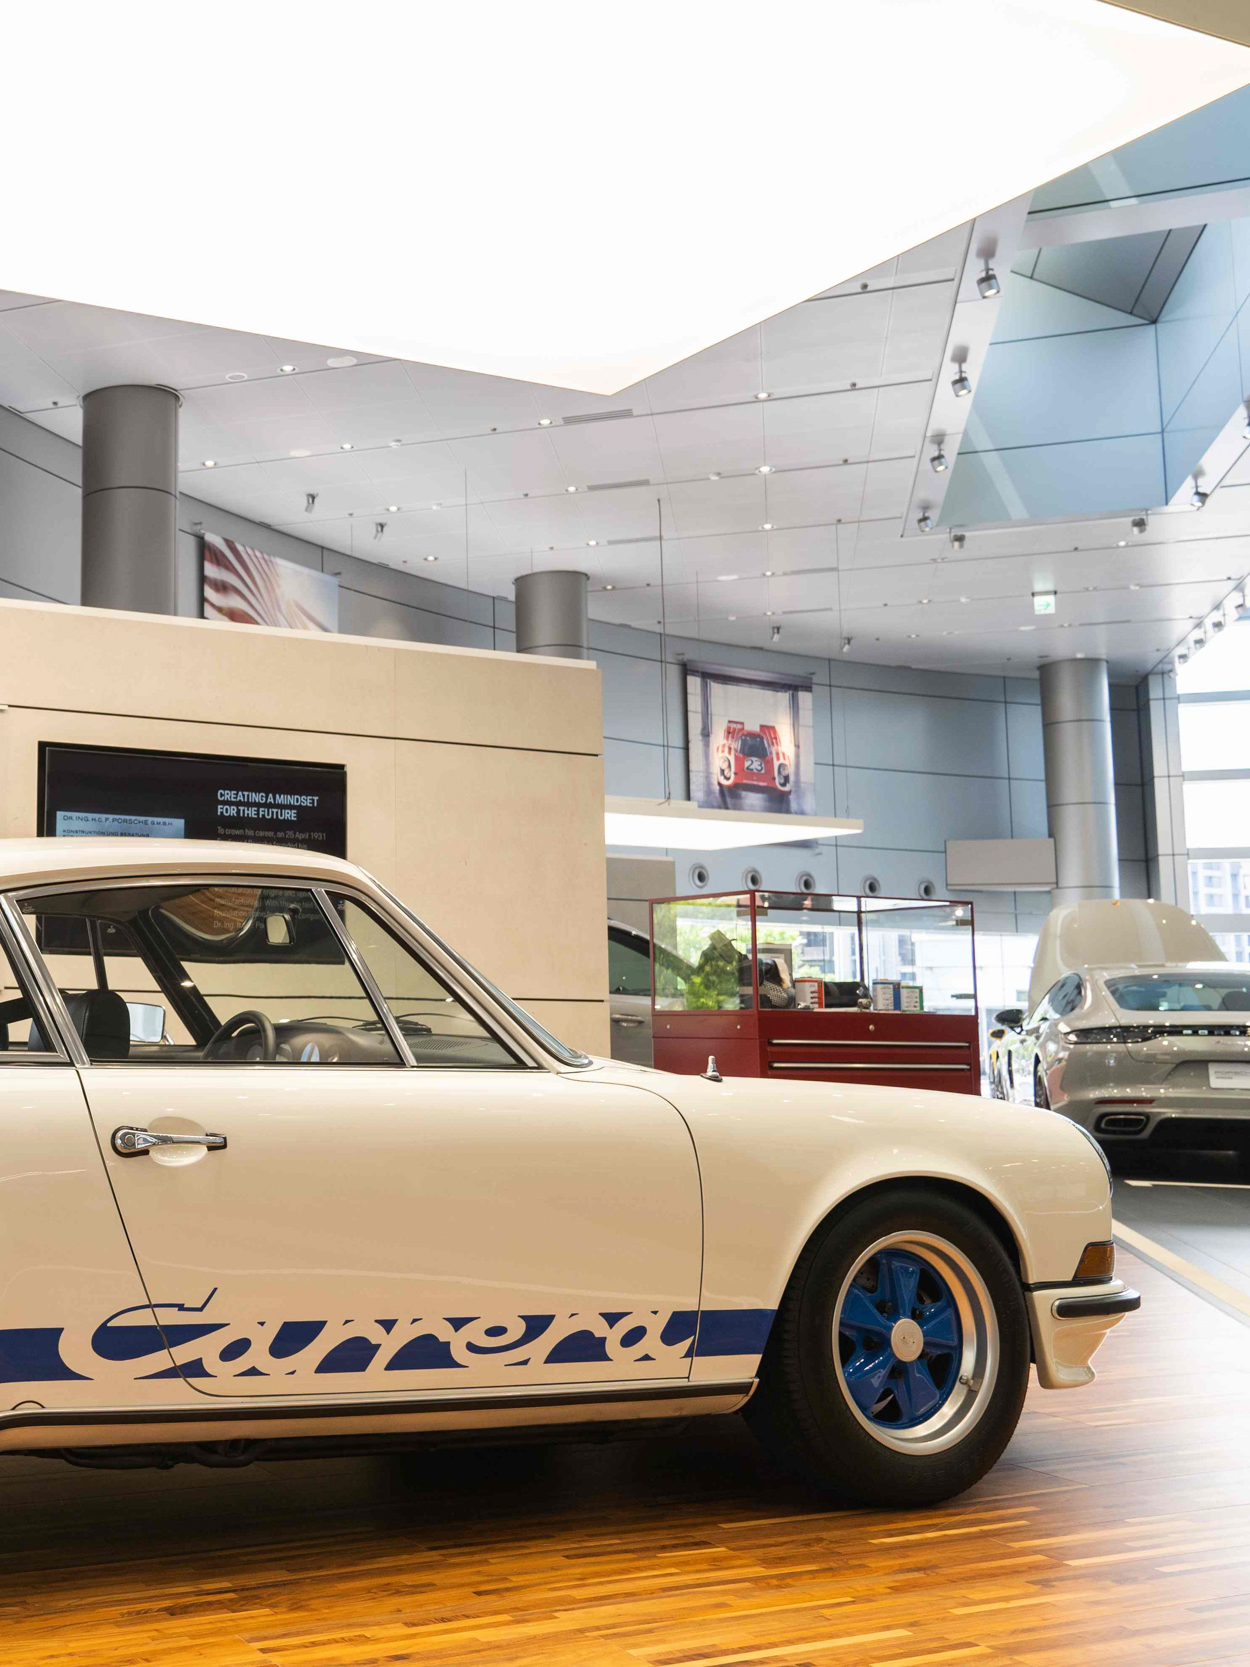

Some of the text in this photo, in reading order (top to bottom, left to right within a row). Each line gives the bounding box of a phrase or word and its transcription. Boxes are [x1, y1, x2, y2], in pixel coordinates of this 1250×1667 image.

[746, 759, 764, 773] 23
[217, 789, 319, 807] CREATING A MINDSET
[217, 805, 297, 820] FOR THE FUTURE
[112, 817, 148, 826] PORSCHE
[217, 826, 225, 834] To
[245, 827, 254, 836] his
[285, 830, 294, 839] 25
[295, 831, 309, 840] April
[310, 832, 326, 840] 1931
[58, 1287, 696, 1381] Carrera
